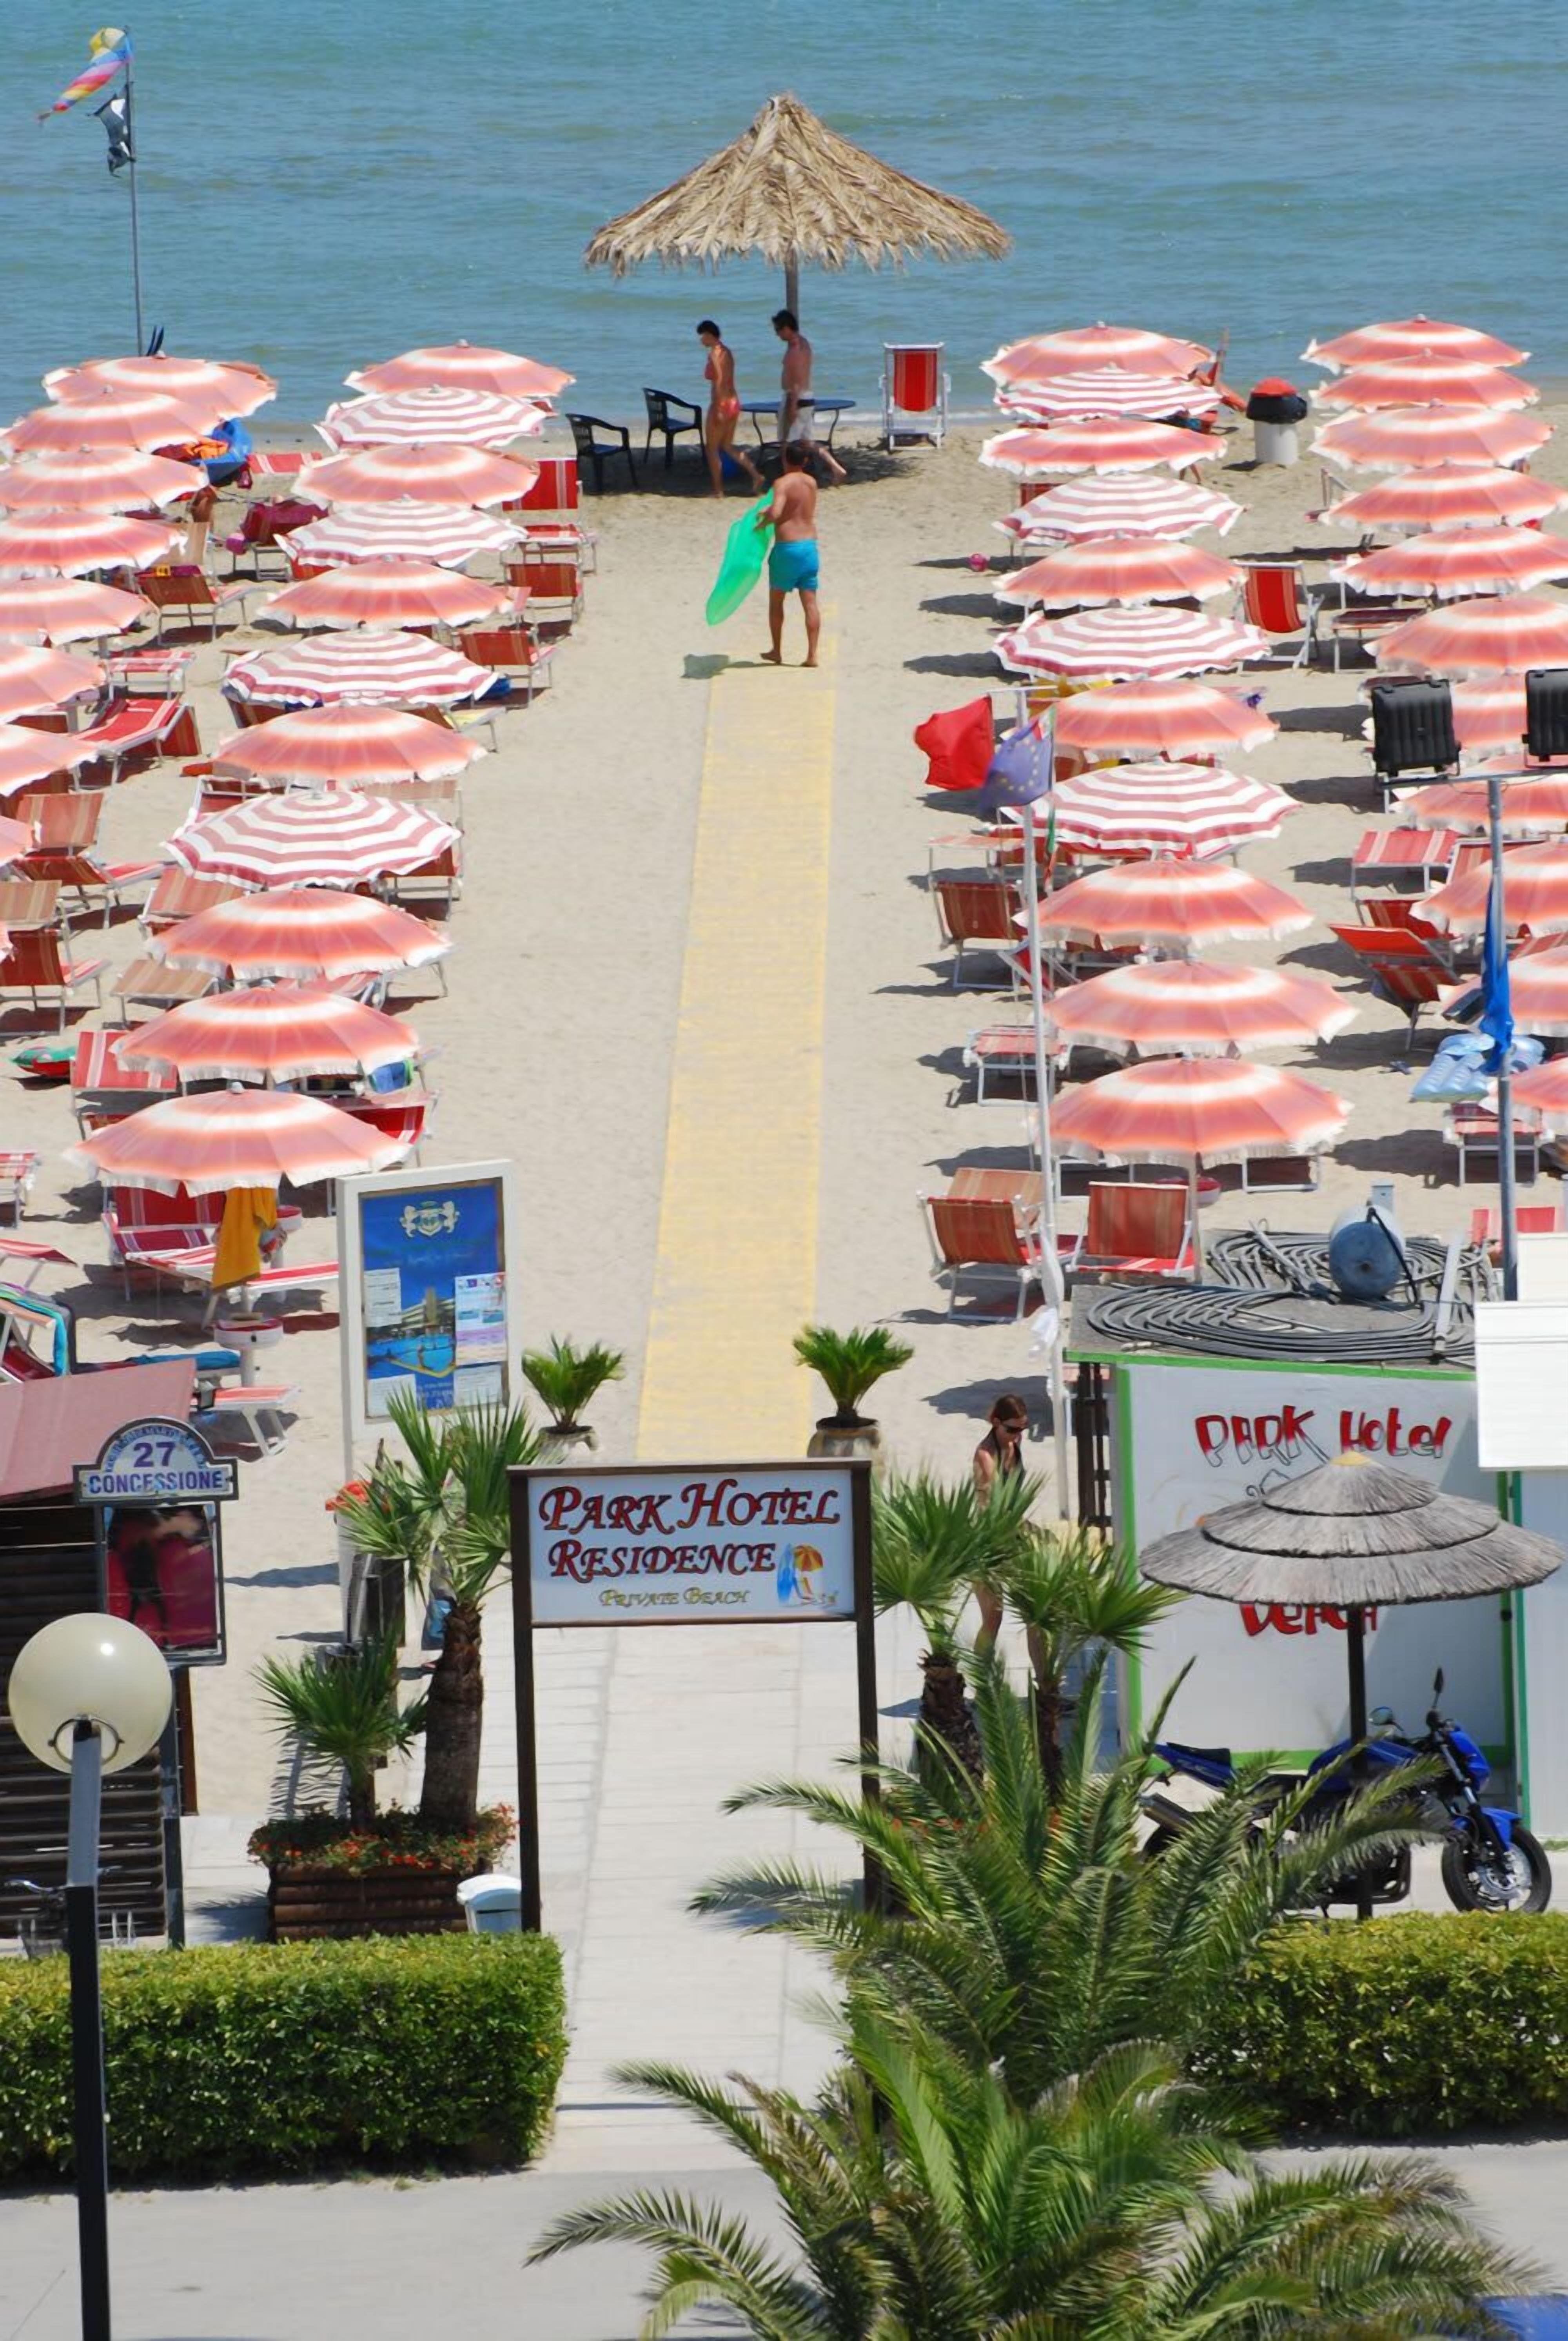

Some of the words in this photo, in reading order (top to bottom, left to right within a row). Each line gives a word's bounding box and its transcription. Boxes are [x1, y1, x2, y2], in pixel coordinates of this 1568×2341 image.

[134, 1442, 175, 1468] 27
[1340, 1408, 1452, 1458] Hotel
[89, 1471, 223, 1494] CONCESSIONE
[539, 1486, 675, 1535] PARK
[677, 1479, 840, 1528] HOTEL
[549, 1539, 776, 1583] RESIDENCE
